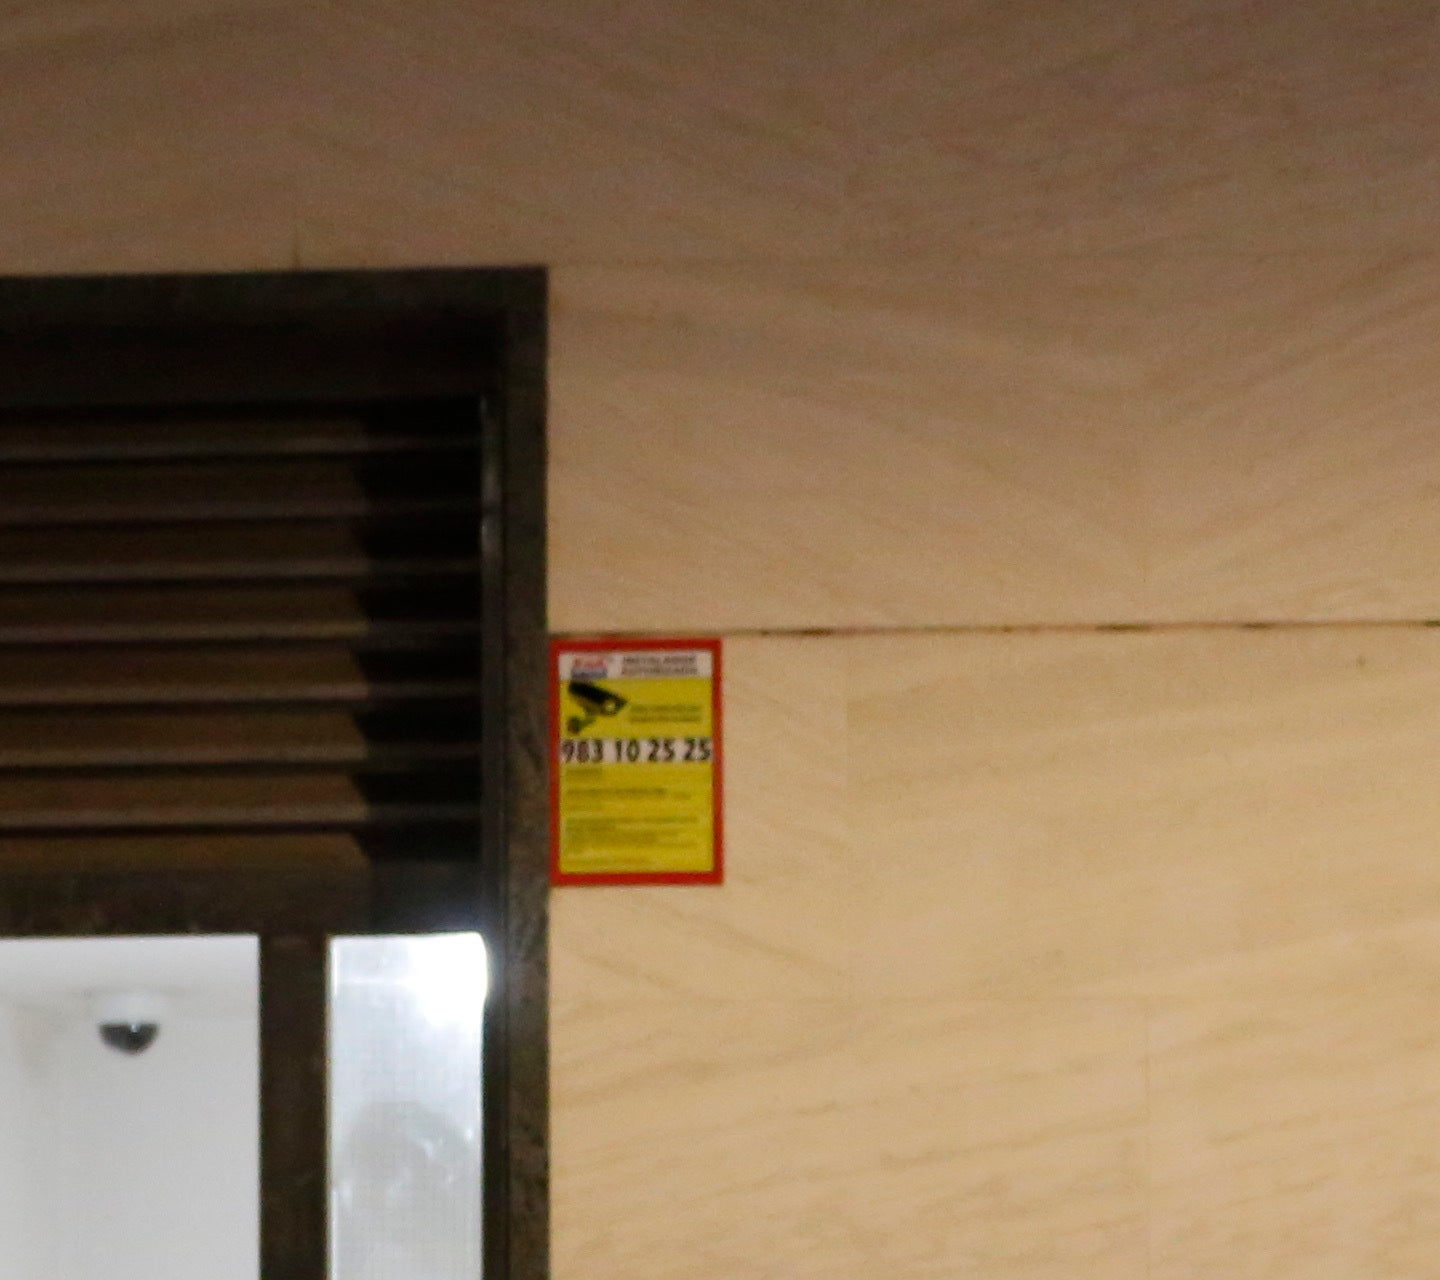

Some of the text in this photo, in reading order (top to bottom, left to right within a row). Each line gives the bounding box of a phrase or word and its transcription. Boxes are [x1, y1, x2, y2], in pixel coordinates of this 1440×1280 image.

[562, 738, 711, 763] 983 10 25 25
